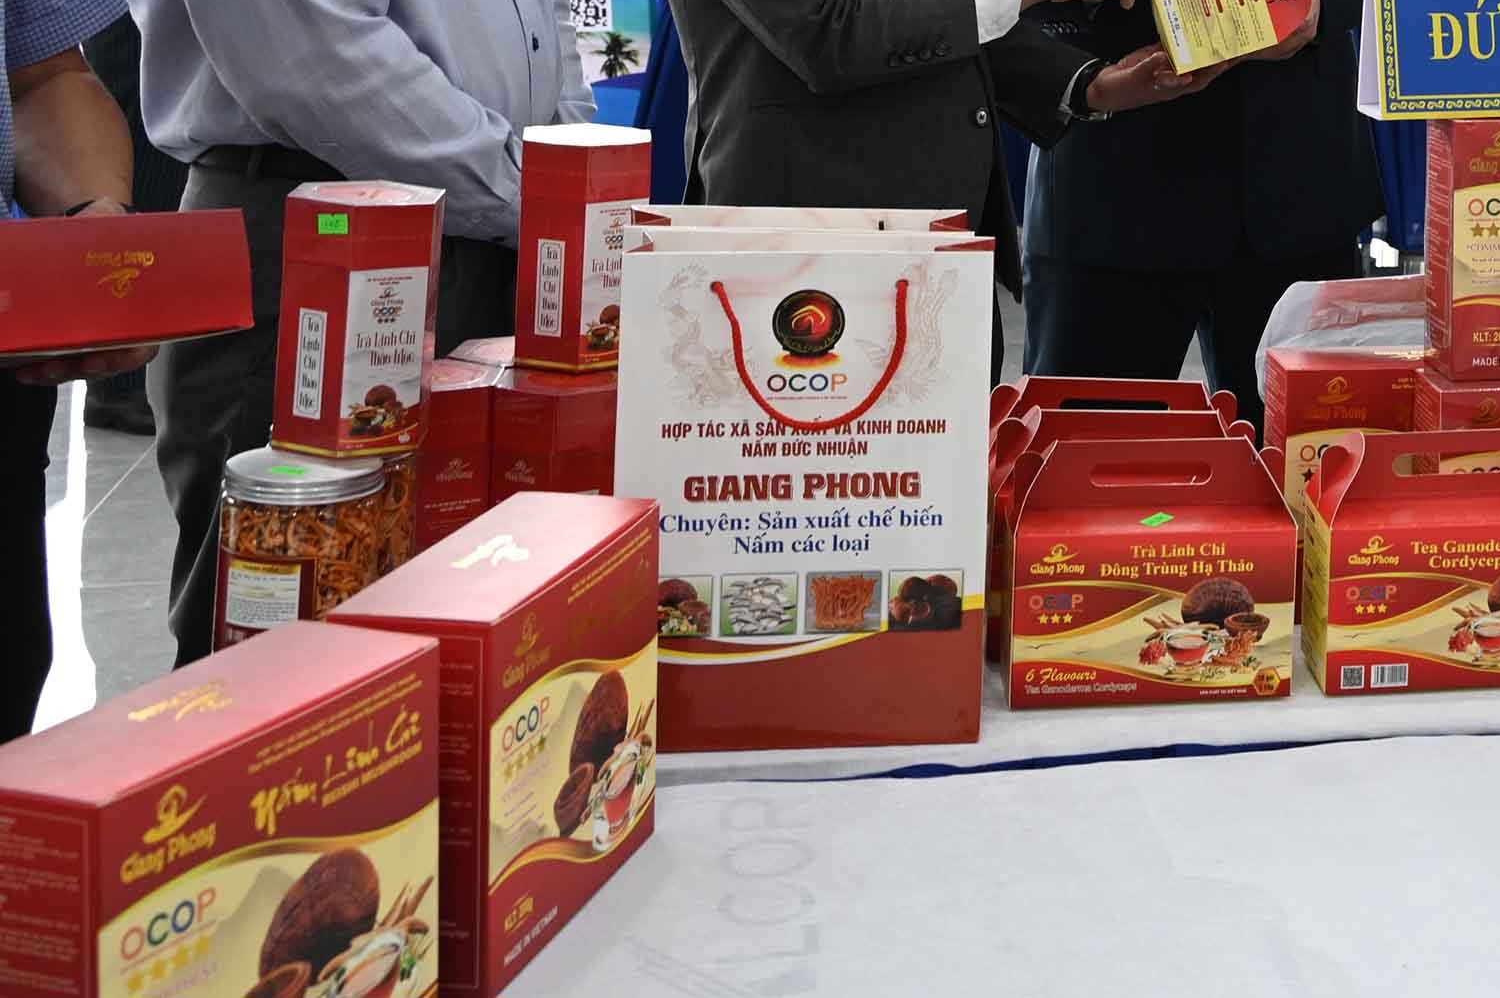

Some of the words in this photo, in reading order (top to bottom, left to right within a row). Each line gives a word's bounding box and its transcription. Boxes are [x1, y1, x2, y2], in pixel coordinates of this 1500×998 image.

[1473, 331, 1492, 343] KLT:
[1473, 357, 1498, 367] MADE
[767, 374, 847, 392] OCOP
[661, 422, 691, 442] HỢP
[698, 422, 724, 437] TÁC
[731, 422, 750, 437] XÃ
[857, 421, 892, 435] KINH
[897, 420, 946, 434] DOANH
[742, 439, 777, 457] NẤM
[782, 439, 811, 456] ĐỨC
[816, 440, 868, 458] NHUẬN
[684, 473, 792, 502] GIANG
[803, 471, 921, 499] PHONG
[660, 513, 750, 536] Chuyên:
[758, 510, 797, 530] Sản
[805, 507, 850, 528] xuất
[858, 507, 895, 527] chế
[901, 506, 943, 527] biến
[734, 534, 784, 554] Nấm
[792, 535, 825, 552] các
[833, 533, 870, 556] loại
[1131, 545, 1156, 559] Trà
[1161, 544, 1195, 558] Linh
[1200, 543, 1225, 557] Chi
[1411, 540, 1437, 555] Tea
[1056, 563, 1085, 575] Phong
[1100, 561, 1138, 579] Đông
[1143, 560, 1186, 577] Trùng
[1193, 560, 1213, 575] Hạ
[1217, 559, 1254, 573] Thảo
[1373, 554, 1399, 567] Phong
[1025, 668, 1034, 682] 6
[1040, 667, 1097, 684] Flavours
[502, 696, 550, 752] OCOP
[120, 887, 216, 961] OCOP
